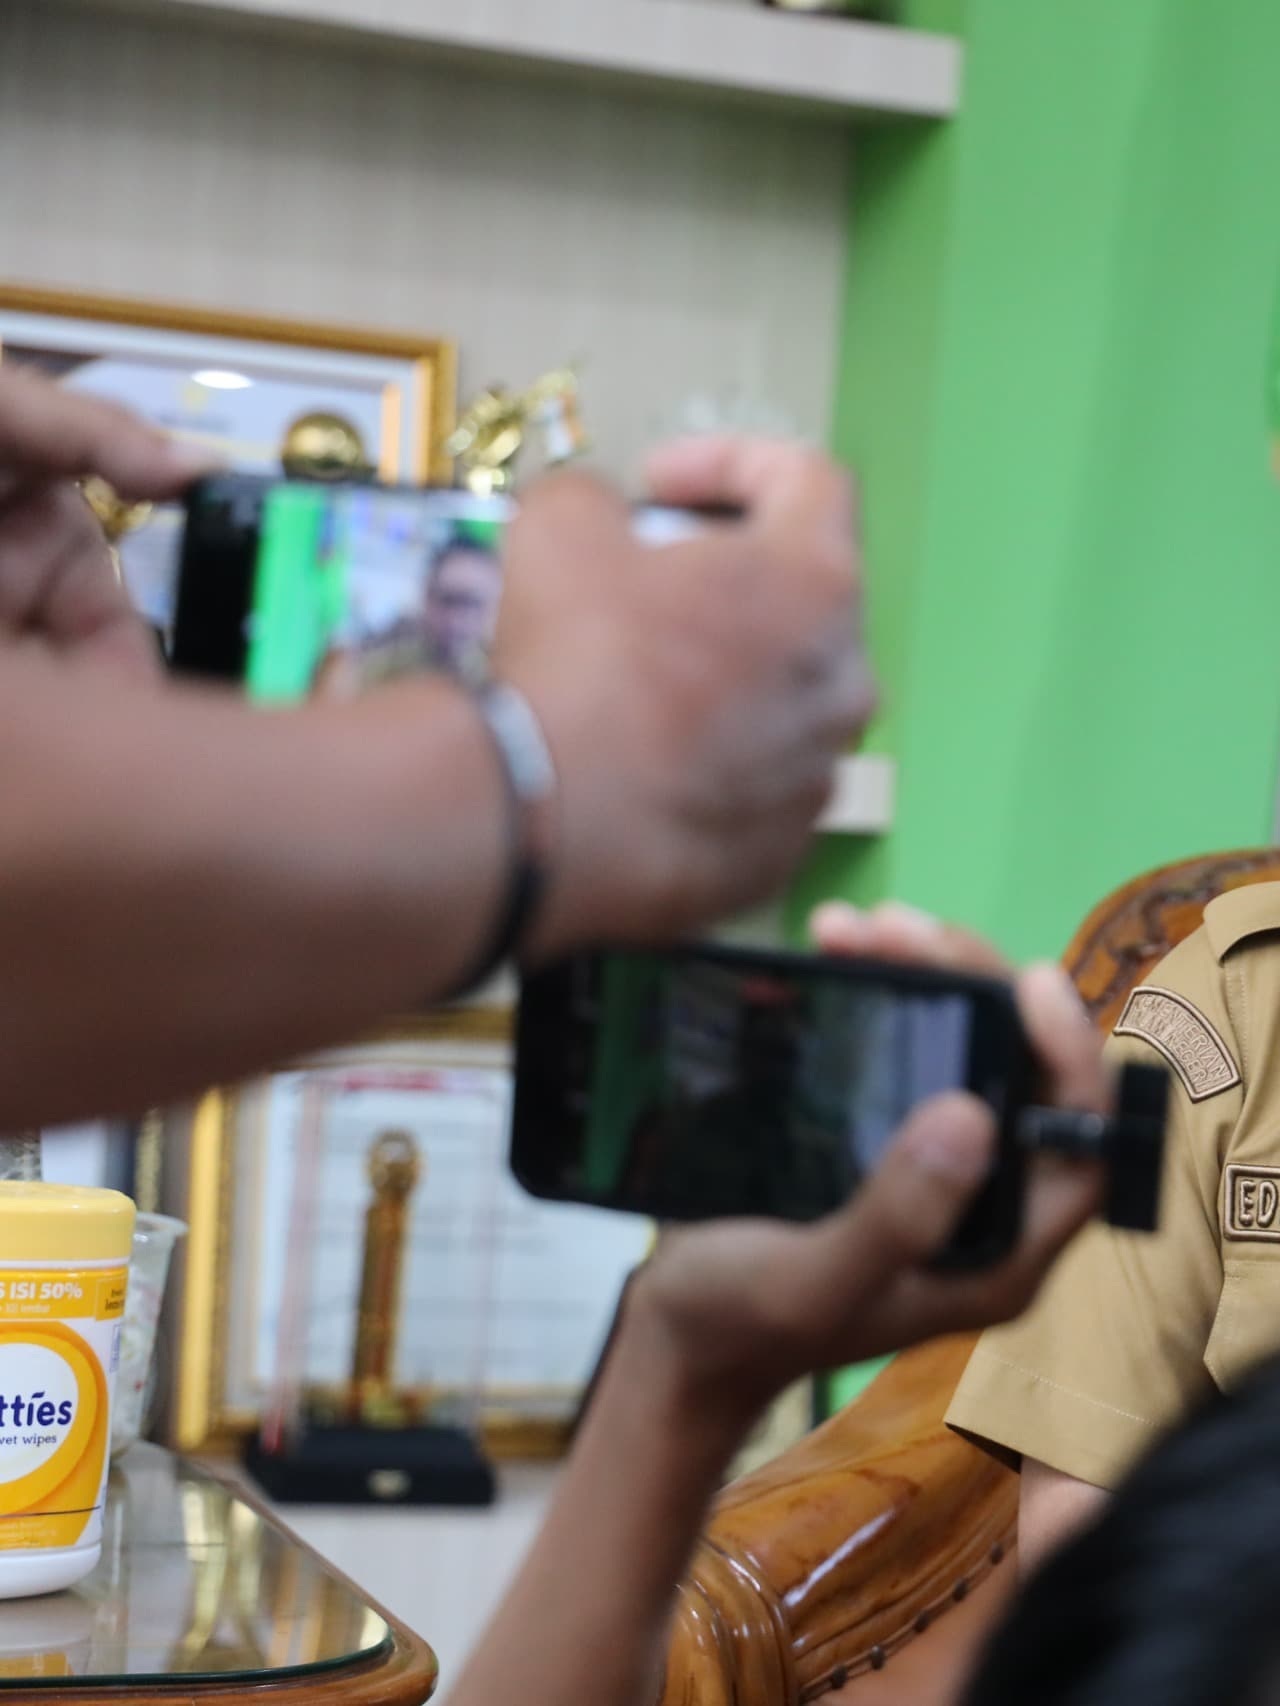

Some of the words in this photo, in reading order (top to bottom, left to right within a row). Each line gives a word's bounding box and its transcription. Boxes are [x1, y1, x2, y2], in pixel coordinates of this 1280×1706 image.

[9, 1281, 36, 1300] ISI
[39, 1281, 83, 1300] 50%
[0, 1391, 72, 1427] tties
[22, 1433, 57, 1447] wipes
